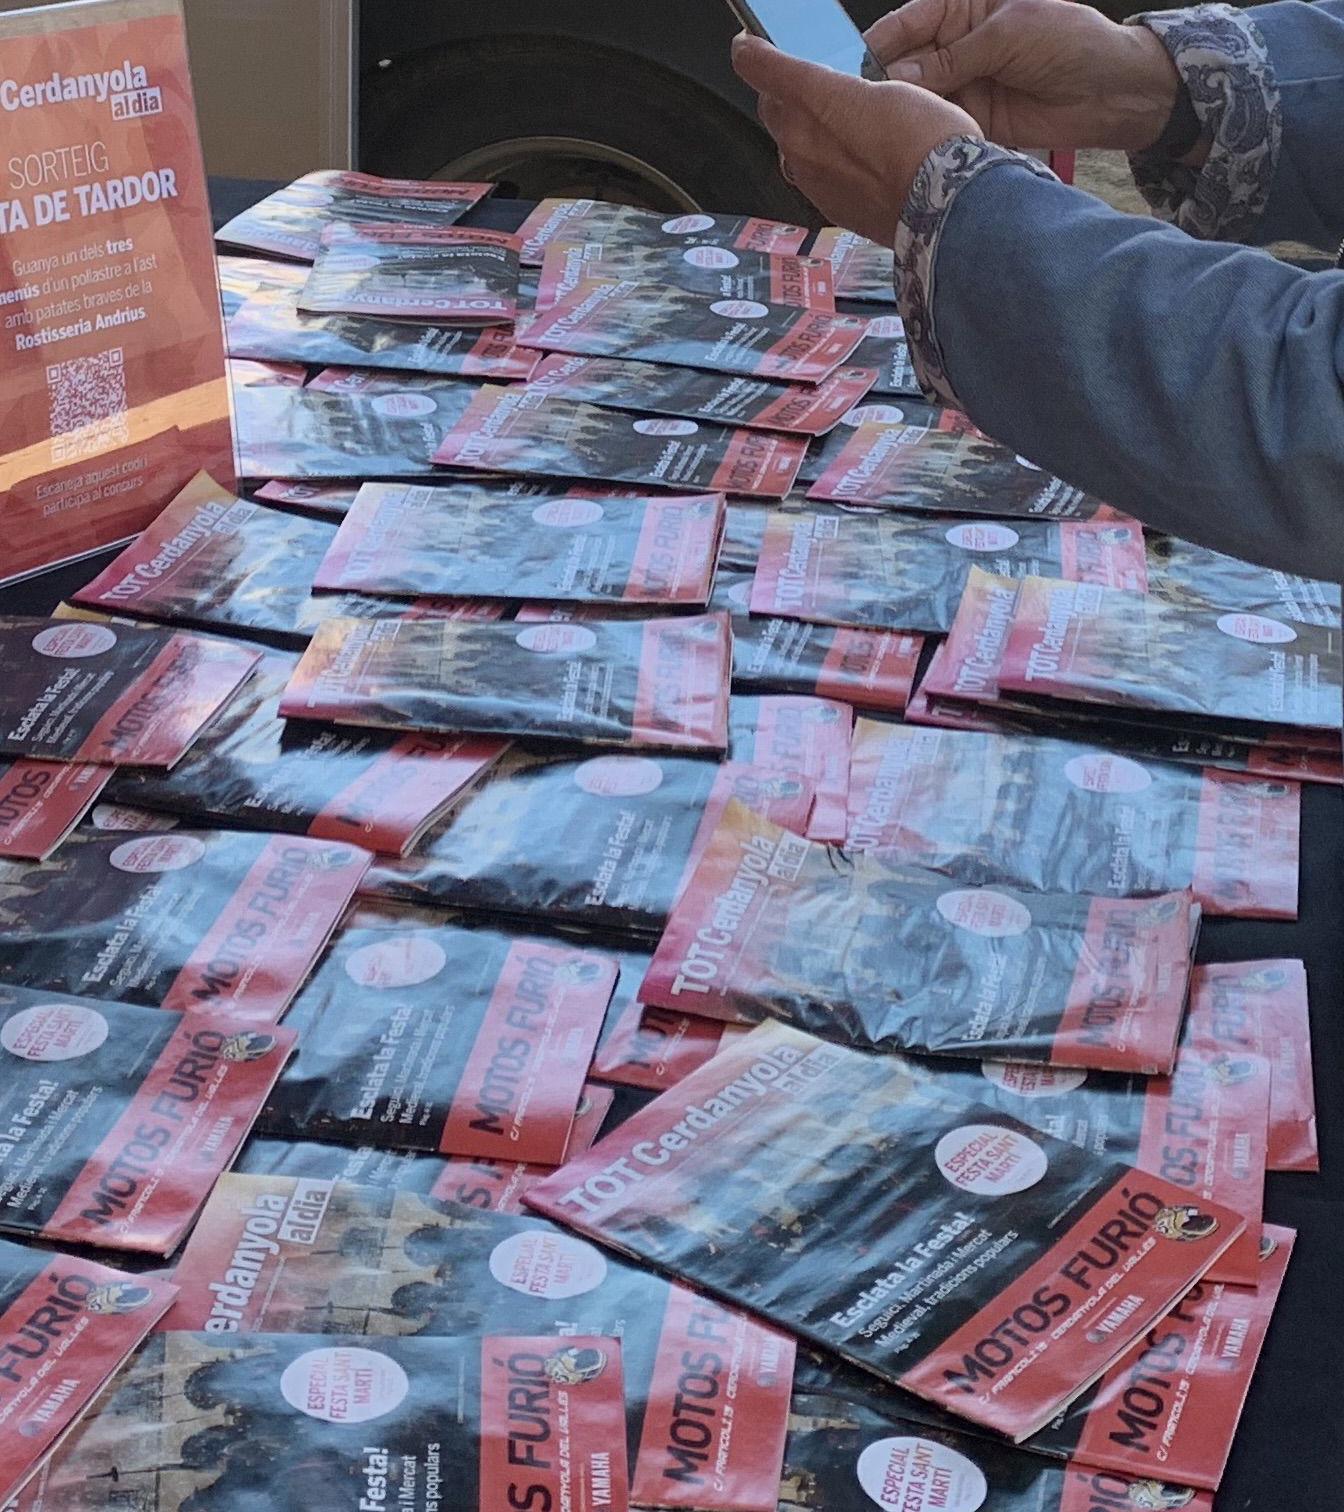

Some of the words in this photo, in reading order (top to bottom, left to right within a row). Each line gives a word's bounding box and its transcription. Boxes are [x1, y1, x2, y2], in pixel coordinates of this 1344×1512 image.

[0, 60, 147, 111] Cerdanyola
[9, 141, 109, 190] SORTEIG
[33, 190, 70, 227] DE
[74, 168, 178, 217] TARDOR
[13, 256, 57, 277] Guanya
[62, 251, 78, 266] un
[80, 245, 105, 261] dels
[106, 238, 133, 255] tres
[42, 277, 69, 294] d'un
[72, 265, 122, 289] pollastre
[124, 262, 131, 275] a
[133, 254, 157, 273] l'ast
[5, 309, 33, 328] amb
[36, 300, 81, 324] patates
[83, 288, 123, 309] braves
[125, 284, 139, 298] de
[142, 281, 152, 294] la
[16, 319, 91, 351] Rostisseria
[95, 306, 146, 330] Andrius
[452, 299, 507, 311] TOT
[538, 320, 568, 343] TOT
[560, 284, 615, 325] Cerdanyola
[457, 436, 492, 463] TOT
[481, 393, 519, 440] Cerdanyola
[765, 398, 810, 427] MOTOS
[36, 474, 84, 500] Escaneja
[85, 464, 121, 489] aquest
[724, 455, 757, 489] MOTOS
[832, 471, 860, 496] TOT
[854, 428, 899, 477] Cerdanyola
[43, 491, 91, 517] participa
[92, 487, 103, 501] al
[104, 477, 144, 497] concurs
[99, 573, 150, 601] TOT
[135, 501, 226, 580] Cerdanyola
[789, 521, 813, 579] Cerdanyola
[775, 568, 805, 608] TOT
[968, 588, 1016, 676] Cerdanyola
[1027, 644, 1060, 681] TOT
[8, 704, 38, 741] Esclata
[36, 694, 51, 708] la
[47, 667, 82, 698] Festa!
[585, 865, 616, 907] Esclata
[191, 918, 268, 1001] MOTOS
[249, 847, 308, 917] FURIÓ
[670, 938, 724, 997] TOT
[699, 833, 775, 947] Cerdanyola
[82, 928, 130, 983] Esclata
[13, 1008, 56, 1050] ESPECIAL
[961, 999, 995, 1043] Esclata
[1075, 986, 1126, 1048] MOTOS
[26, 1029, 56, 1057] FESTA
[469, 1038, 532, 1135] MOTOS
[506, 955, 553, 1032] FURIÓ
[12, 1079, 60, 1129] Festa!
[74, 1085, 104, 1125] populars
[350, 1066, 390, 1120] Esclata
[8, 1125, 25, 1142] la
[79, 1124, 172, 1225] MOTOS
[150, 1030, 224, 1122] FURIÓ
[201, 1116, 234, 1153] YAMAHA
[557, 1158, 645, 1212] TOT
[632, 1044, 804, 1166] Cerdanyola
[944, 1132, 998, 1173] ESPECIAL
[955, 1158, 992, 1188] FESTA
[987, 1135, 1021, 1161] SANT
[984, 1152, 1022, 1184] MARTÍ
[289, 1218, 316, 1243] al
[304, 1188, 329, 1221] dia
[510, 1237, 535, 1285] ESPECIAL
[528, 1264, 550, 1297] FESTA
[540, 1235, 559, 1269] SANT
[830, 1269, 906, 1328] Esclata
[895, 1255, 922, 1274] la
[914, 1211, 976, 1259] Festa!
[899, 1259, 954, 1303] Martinada
[953, 1229, 993, 1263] Mercat
[924, 1259, 978, 1306] tradicions
[973, 1229, 1020, 1269] populars
[942, 1284, 1072, 1395] MOTOS
[1059, 1188, 1166, 1291] FURIÓ
[1051, 1287, 1107, 1340] CERDANYOLA
[1104, 1271, 1124, 1289] DEL
[1095, 1294, 1145, 1334] YAMAHA
[1220, 1318, 1250, 1358] YAMAHA
[306, 1357, 329, 1412] ESPECIAL
[334, 1350, 353, 1385] SANT
[353, 1368, 373, 1405] MARTÍ
[1108, 1329, 1188, 1453] MOTOS
[31, 1379, 80, 1423] YAMAHA
[329, 1384, 349, 1420] FESTA
[492, 1354, 553, 1469] FURIÓ
[662, 1350, 723, 1485] MOTOS
[359, 1446, 390, 1512] Festa!
[398, 1454, 417, 1494] Mercat
[425, 1442, 441, 1501] populars
[591, 1451, 612, 1509] YAMAHA
[880, 1447, 912, 1505] ESPECIAL
[913, 1443, 936, 1478] SANT
[927, 1466, 953, 1508] MARTÍ
